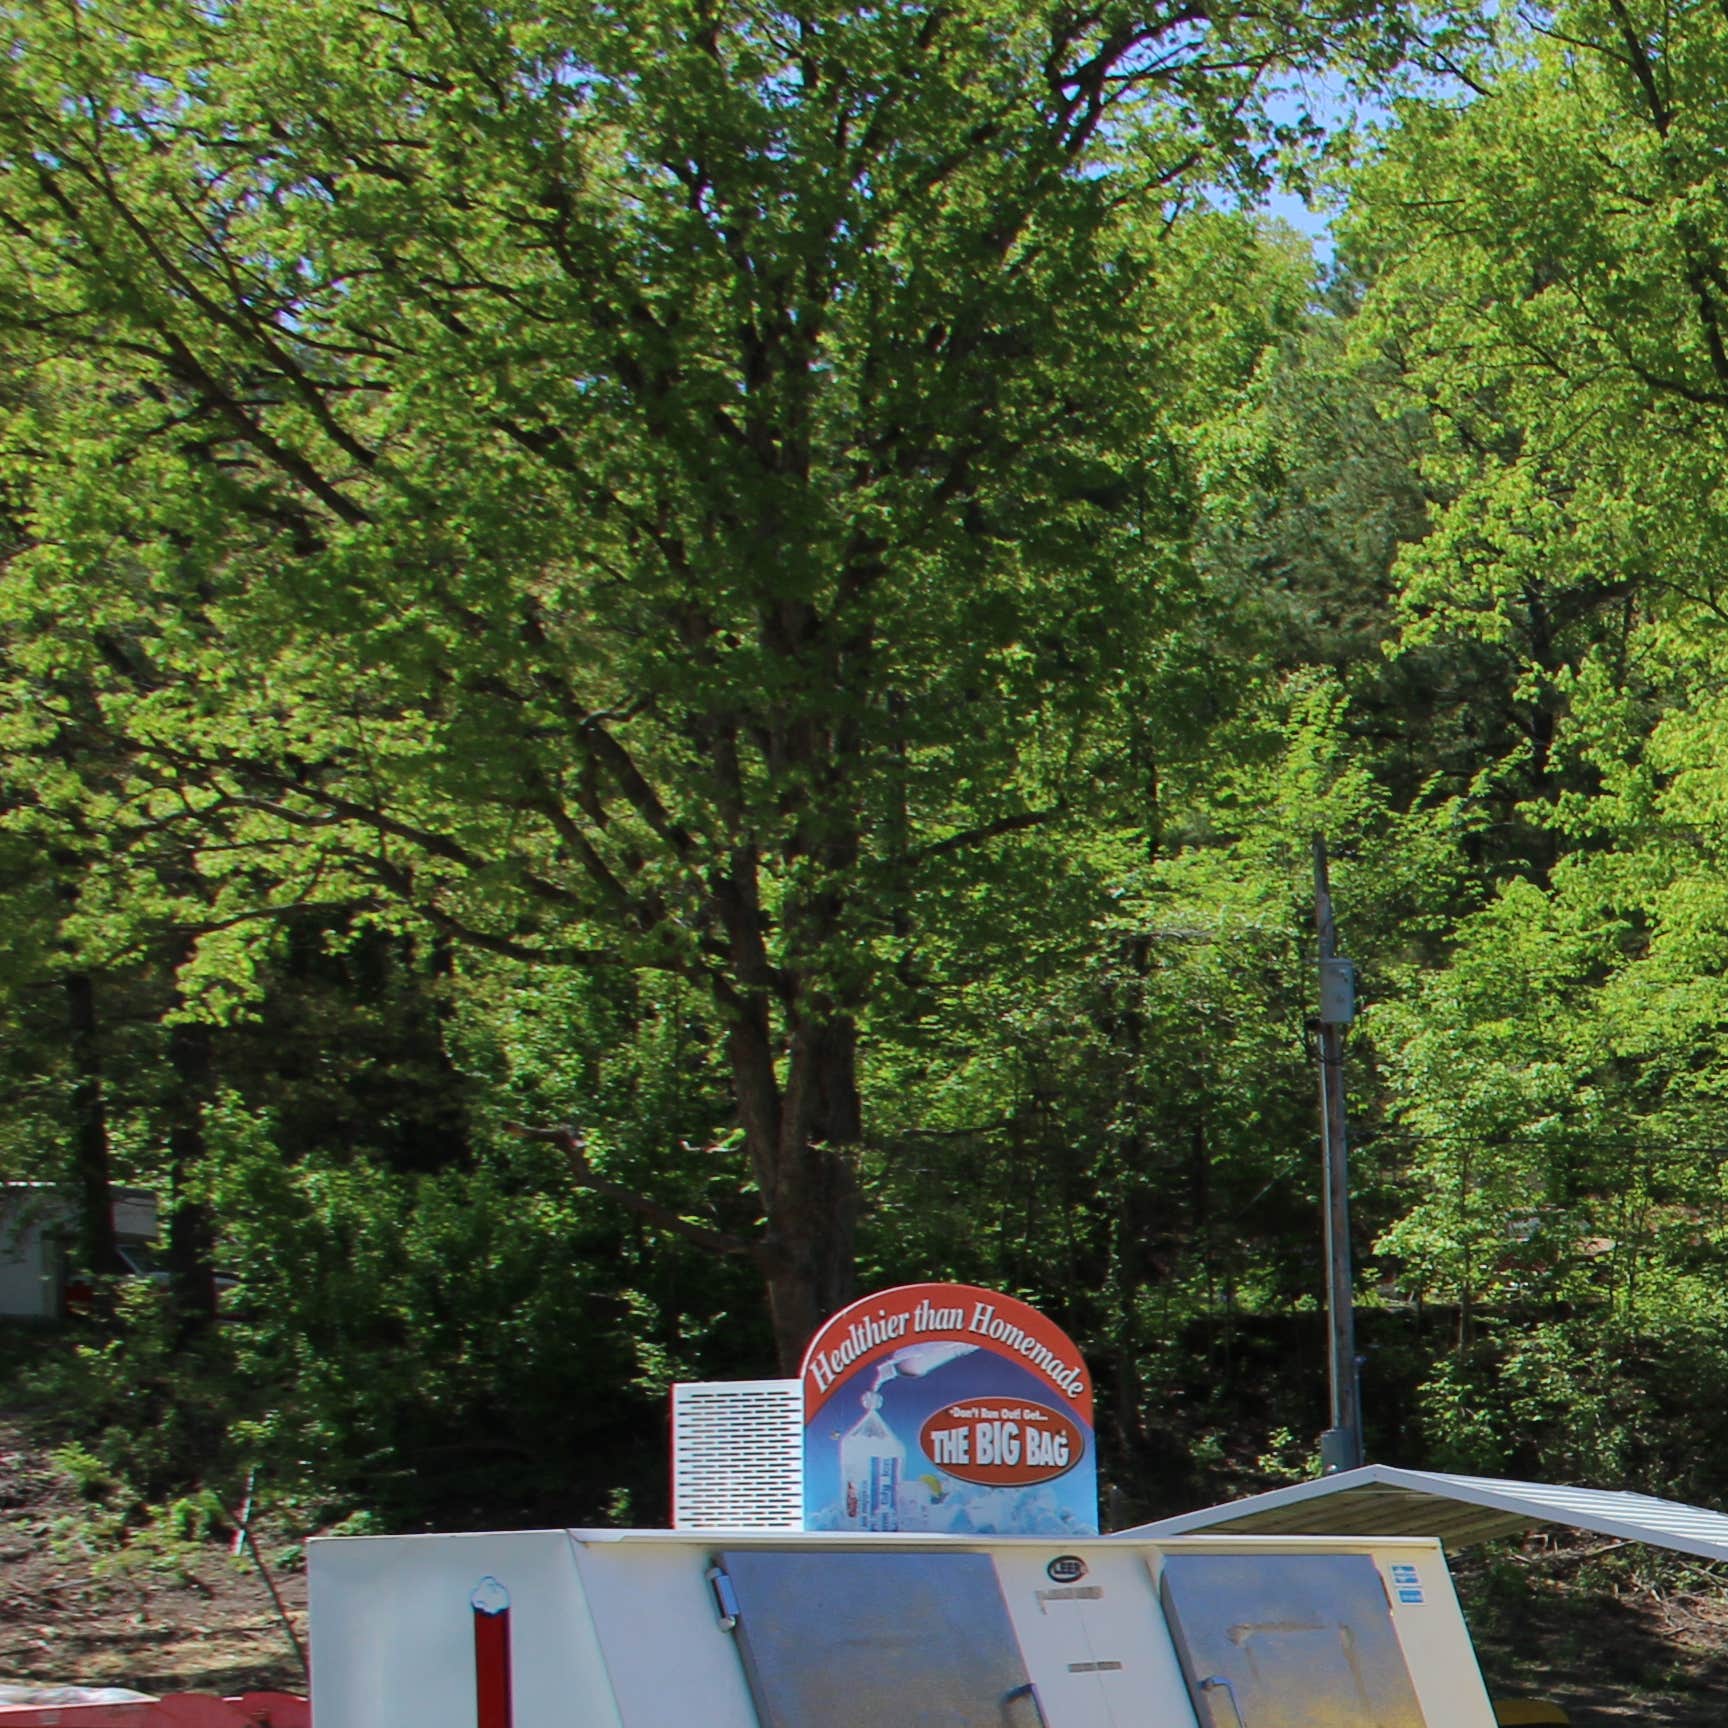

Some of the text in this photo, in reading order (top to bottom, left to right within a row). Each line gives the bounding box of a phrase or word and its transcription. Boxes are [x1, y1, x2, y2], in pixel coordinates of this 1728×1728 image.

[809, 1300, 1083, 1398] Healthier than Homemade
[981, 1408, 999, 1419] Run
[931, 1421, 1069, 1467] THE BIG BAG
